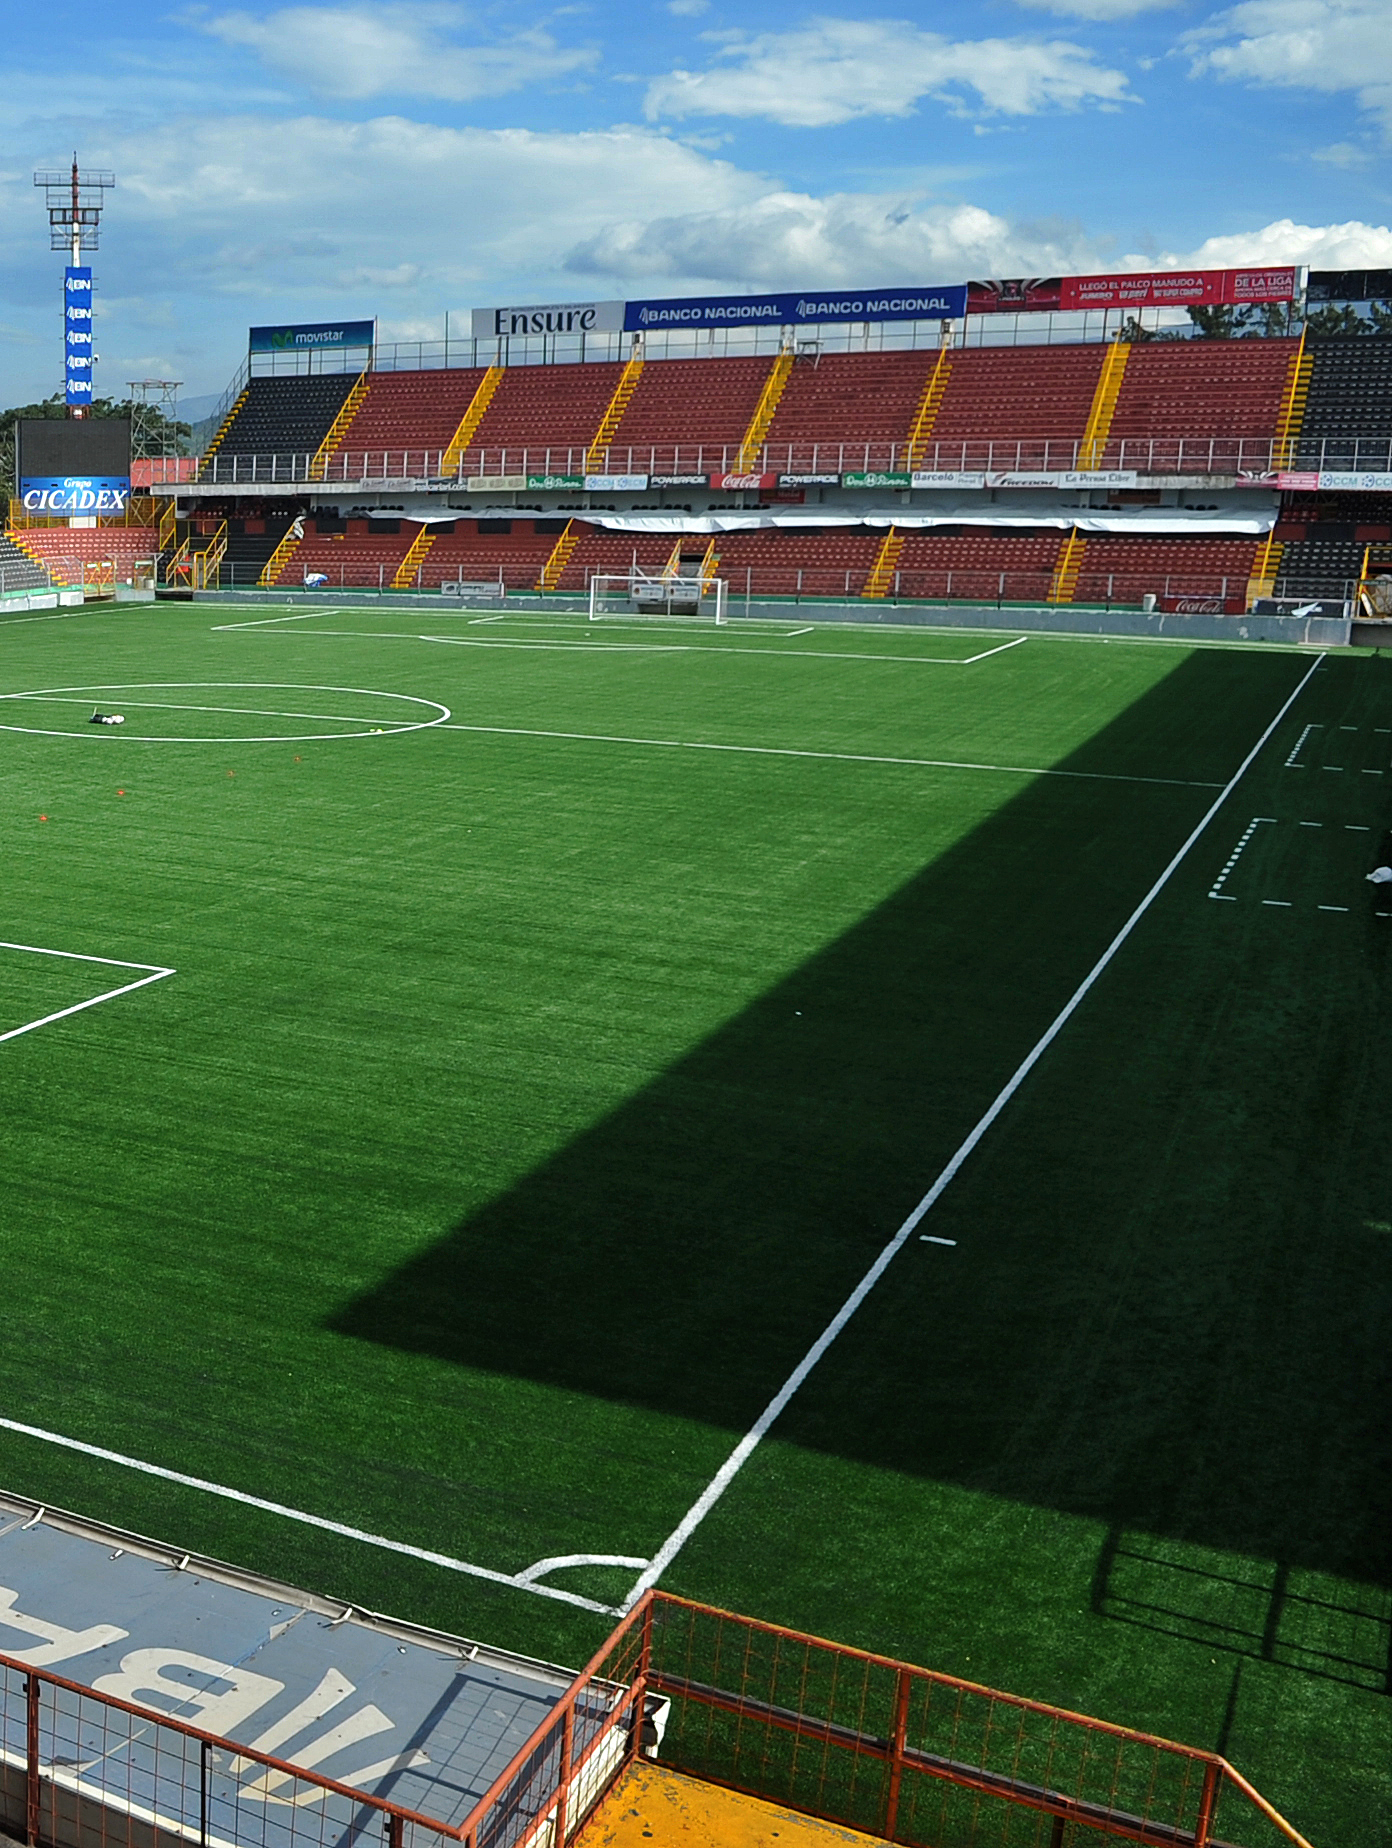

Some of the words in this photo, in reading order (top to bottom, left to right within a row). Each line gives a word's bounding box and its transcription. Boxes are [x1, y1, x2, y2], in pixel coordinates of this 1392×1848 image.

[73, 279, 91, 290] BN
[1109, 281, 1120, 290] EL
[1120, 279, 1151, 289] PALCO
[1151, 278, 1194, 288] MANUDO
[1195, 278, 1204, 286] A
[1235, 278, 1249, 287] DE
[1251, 277, 1265, 287] LA
[1268, 276, 1292, 286] LIGA
[806, 301, 864, 316] BANCO
[866, 297, 950, 313] NACIONAL
[74, 308, 92, 319] BN
[649, 307, 701, 322] BANCO
[704, 304, 782, 319] NACIONAL
[495, 308, 596, 335] Ensure
[74, 332, 92, 344] BN
[295, 329, 344, 345] movistar
[74, 357, 92, 368] BN
[74, 382, 92, 392] BN
[650, 475, 707, 485] POWERADE
[721, 474, 764, 489] Coca-Cola
[779, 475, 839, 485] POWERADE
[846, 475, 865, 486] Dos
[913, 472, 954, 482] Barceló
[1333, 477, 1358, 486] CCM
[63, 477, 93, 492] Grupo
[23, 489, 128, 510] CICADEX
[1175, 600, 1223, 613] Coca-Cola
